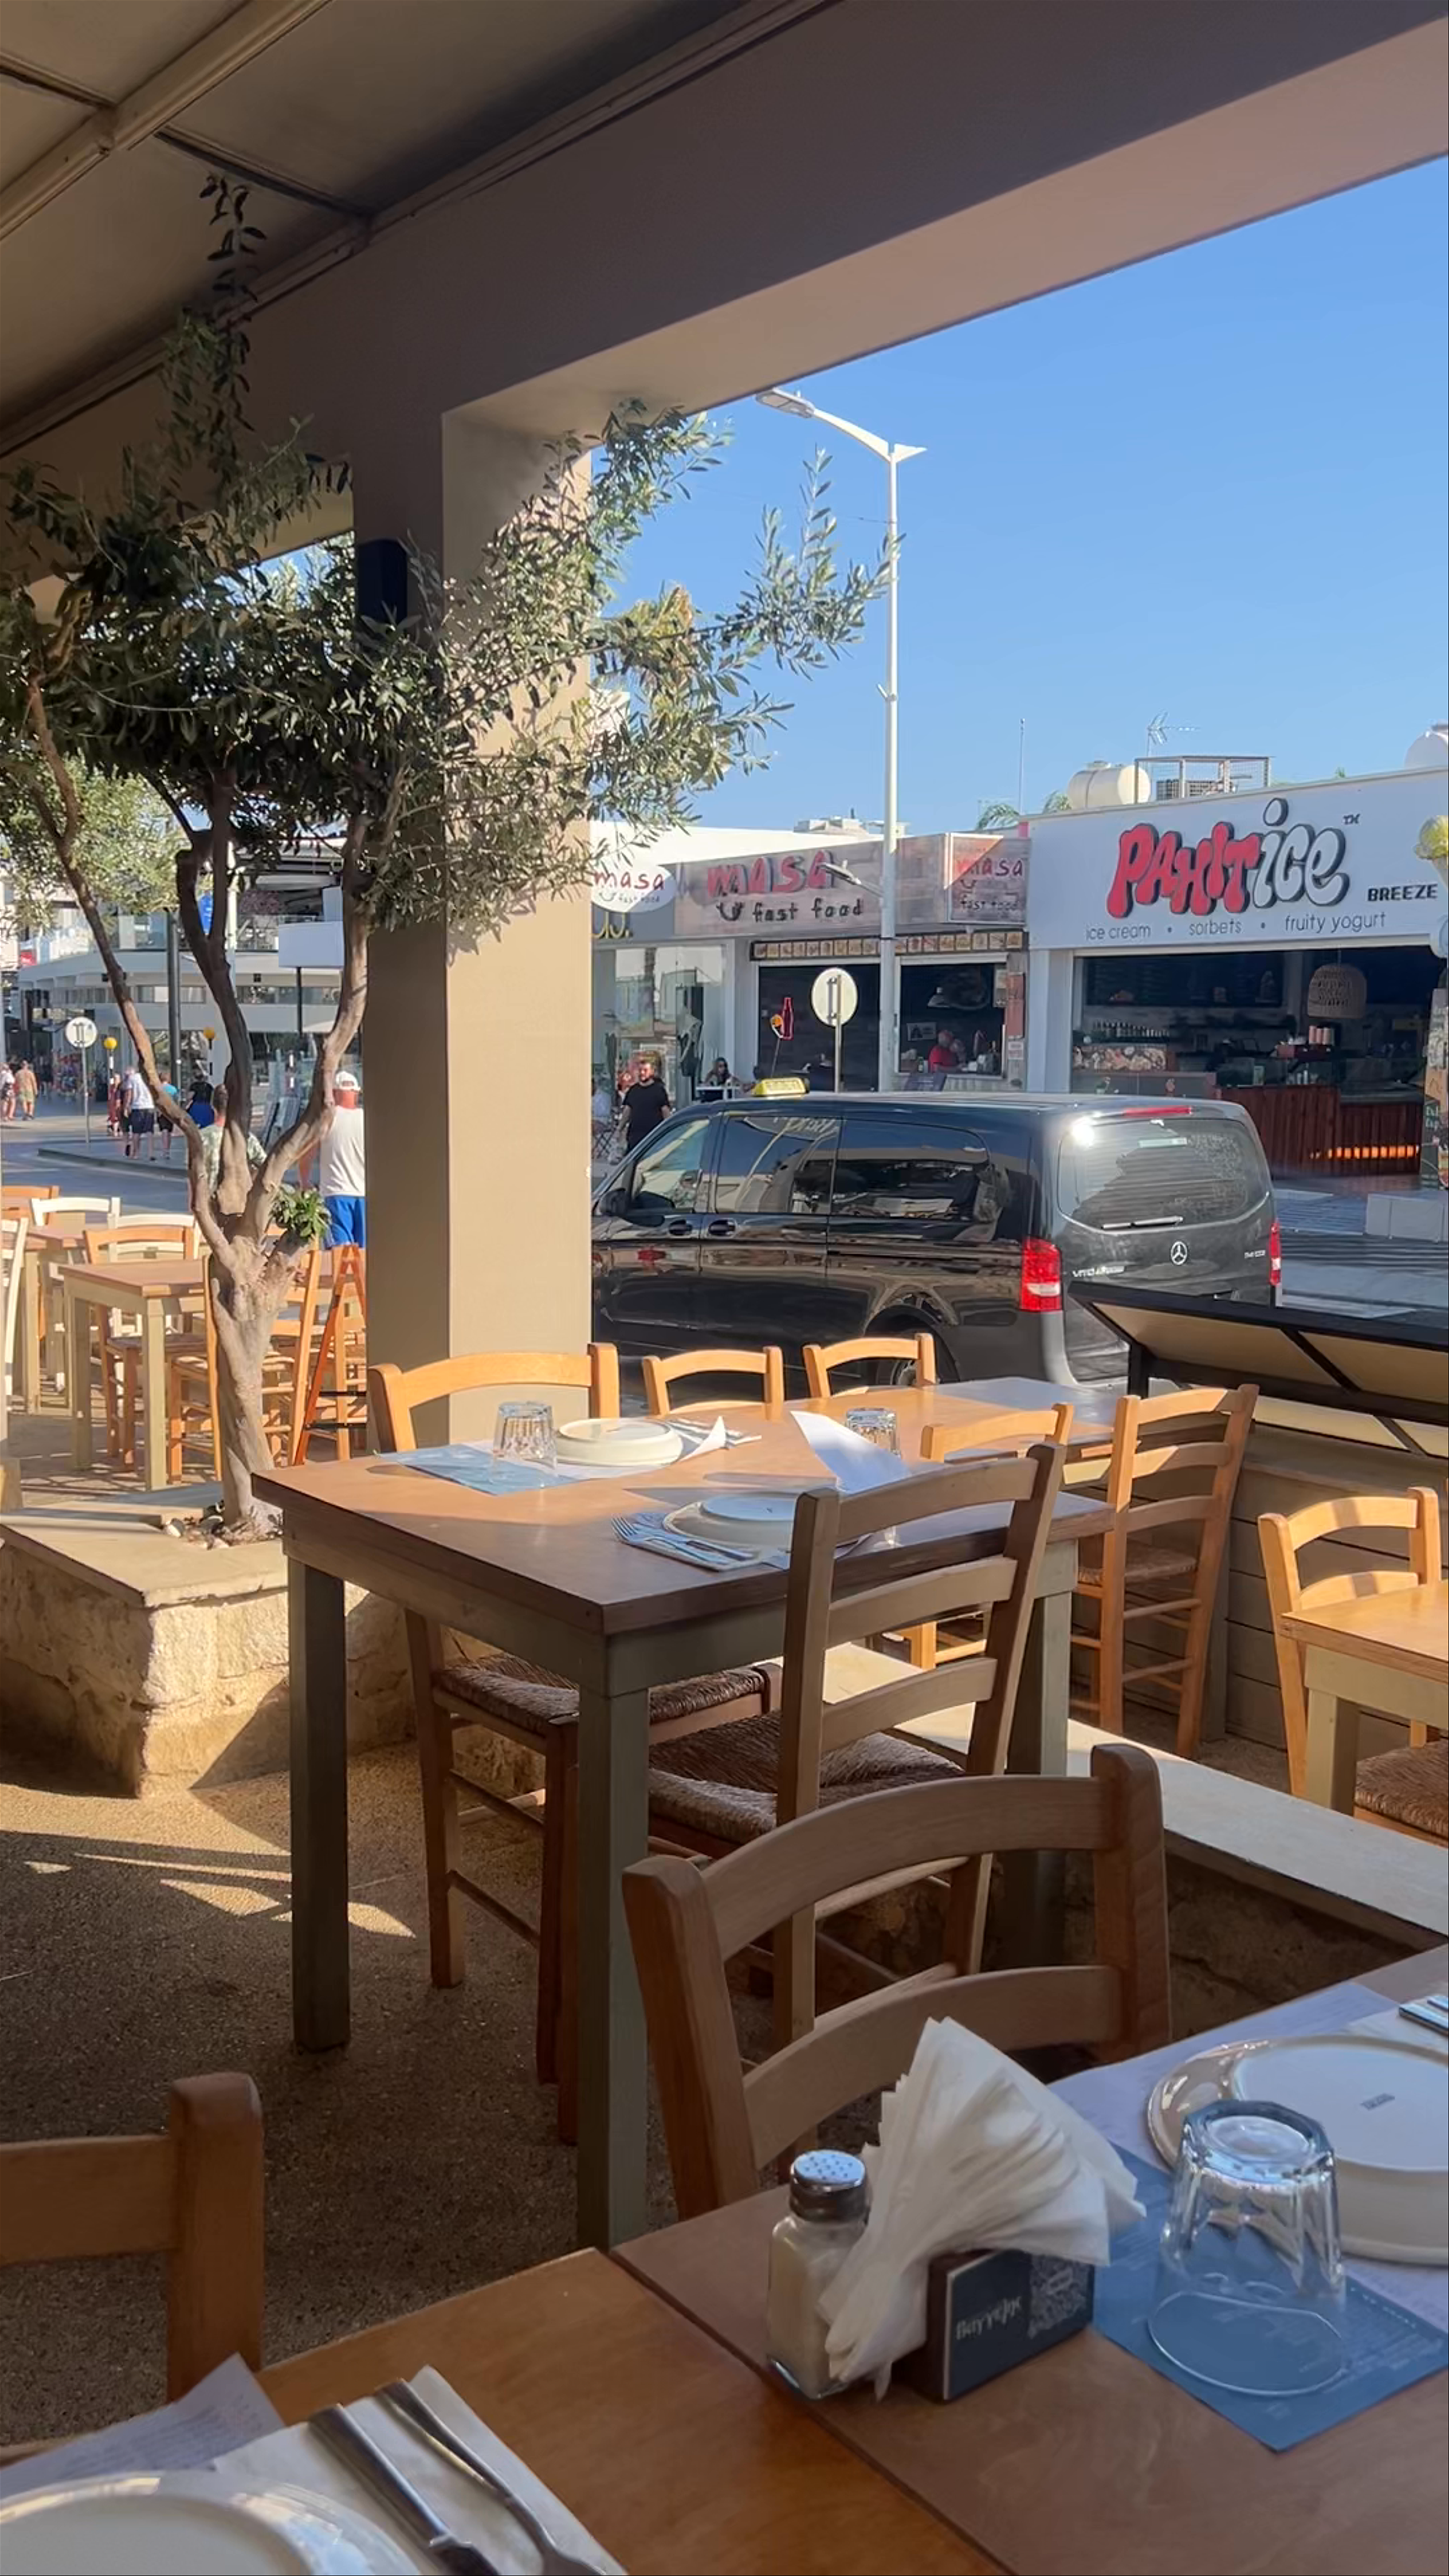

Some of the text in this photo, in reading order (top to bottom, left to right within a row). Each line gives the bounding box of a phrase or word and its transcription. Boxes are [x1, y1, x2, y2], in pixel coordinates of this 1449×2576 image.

[1367, 883, 1438, 902] BREEZE
[752, 897, 863, 923] fast food
[1086, 911, 1386, 940] ice cream sorbets fruity yogurt
